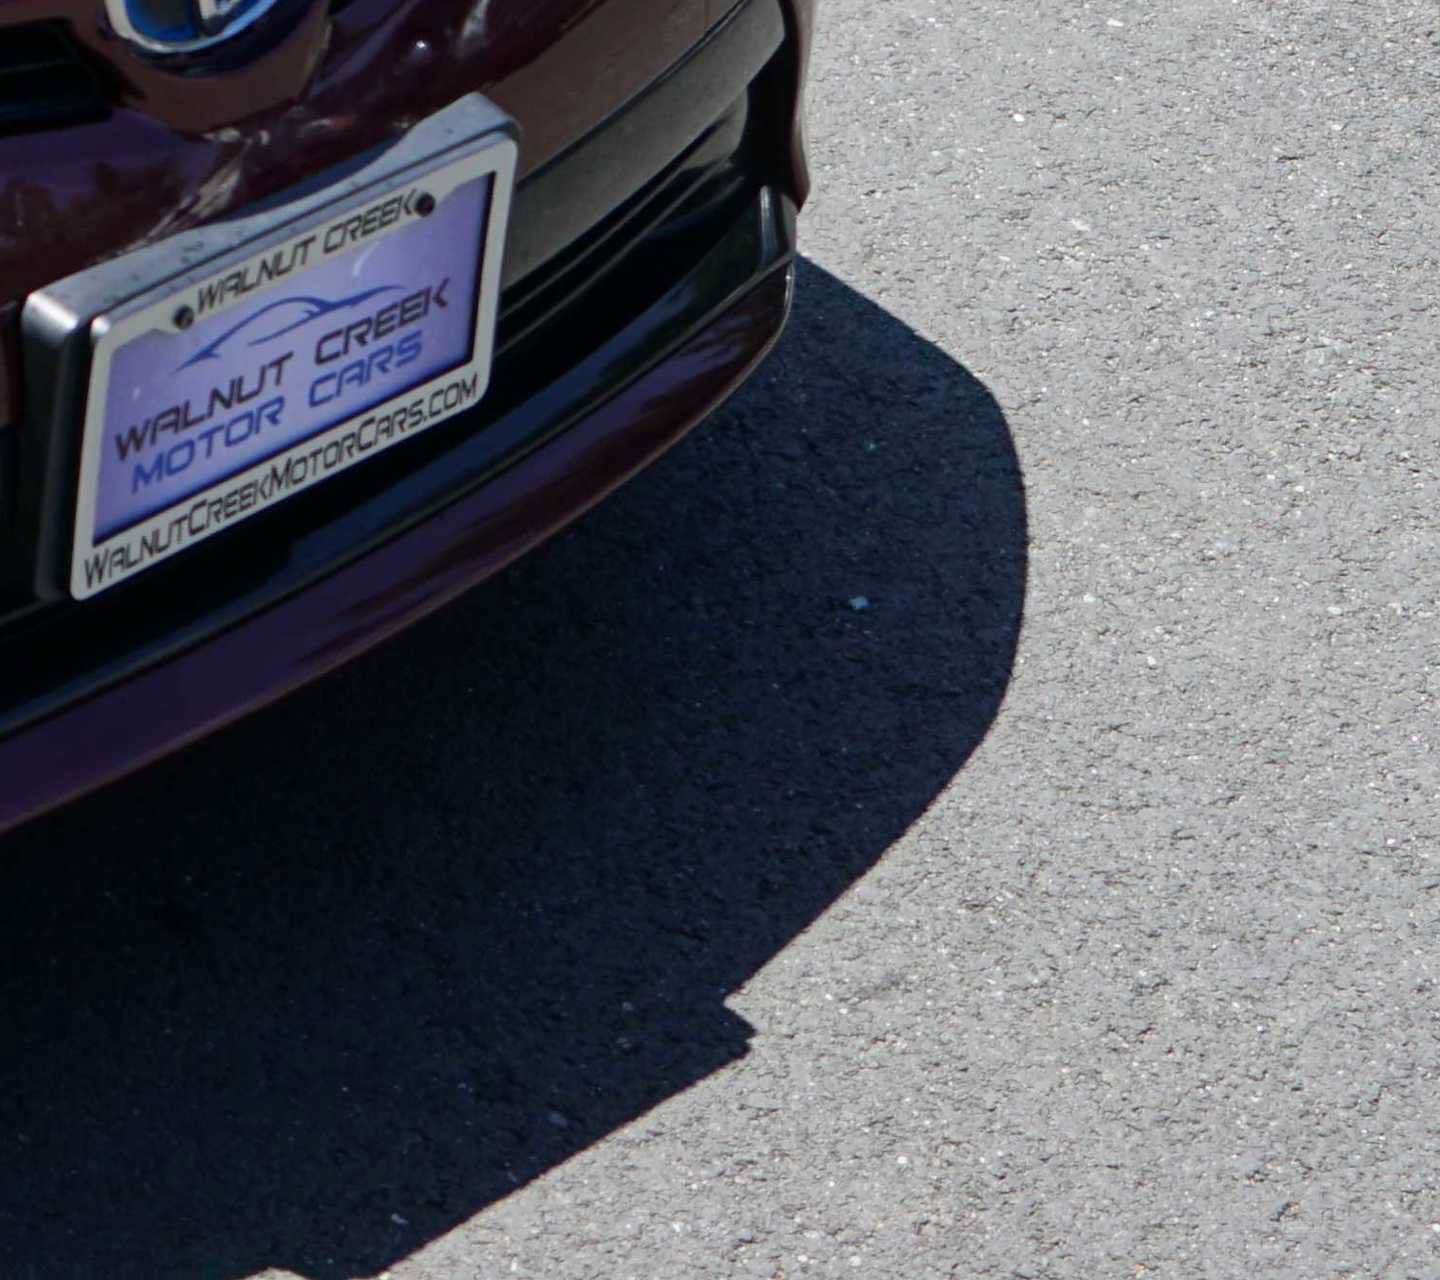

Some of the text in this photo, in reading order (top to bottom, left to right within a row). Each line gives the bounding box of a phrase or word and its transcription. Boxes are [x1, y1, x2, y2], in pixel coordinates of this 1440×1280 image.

[196, 188, 418, 317] WALNUT CREEK
[114, 277, 449, 461] WALNUT CREEK
[130, 329, 424, 494] MOTOR CARS
